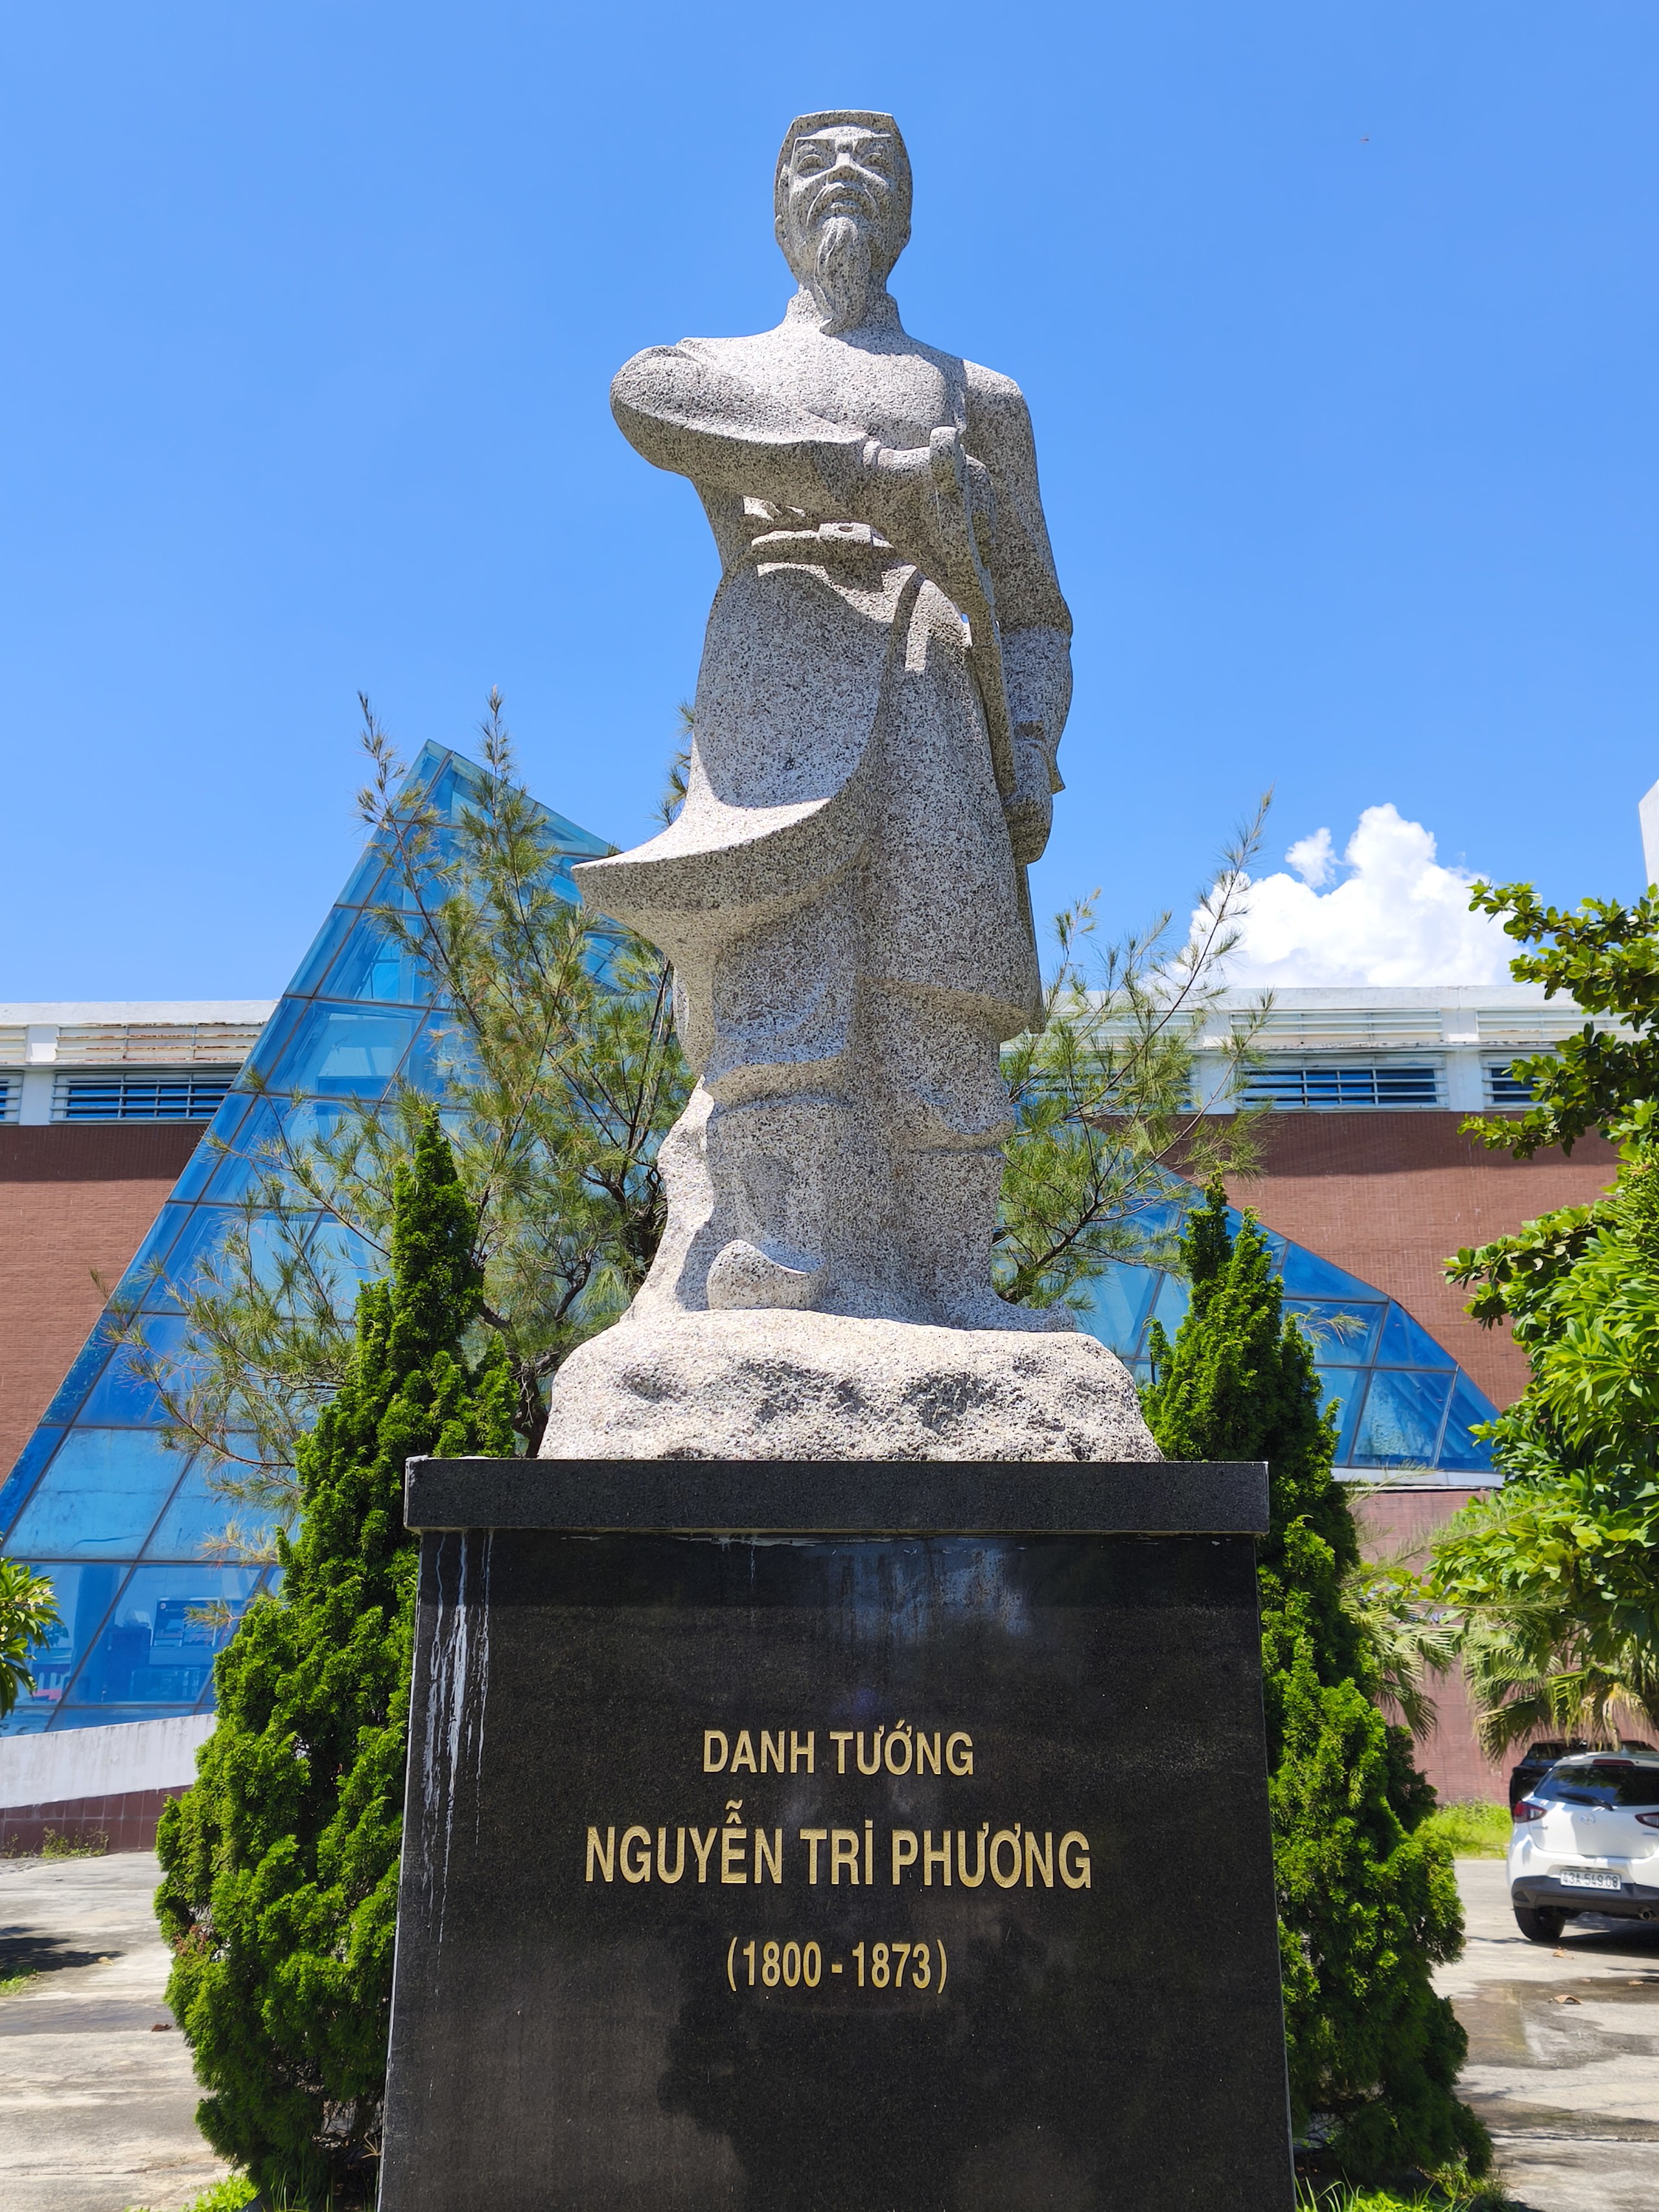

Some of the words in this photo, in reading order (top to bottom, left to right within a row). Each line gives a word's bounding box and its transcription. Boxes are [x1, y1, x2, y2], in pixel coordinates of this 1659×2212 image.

[703, 1730, 815, 1773] DANH
[830, 1719, 974, 1776] TƯỚNG
[585, 1799, 783, 1884] NGUYỄN
[892, 1822, 1092, 1889] PHƯƠNG
